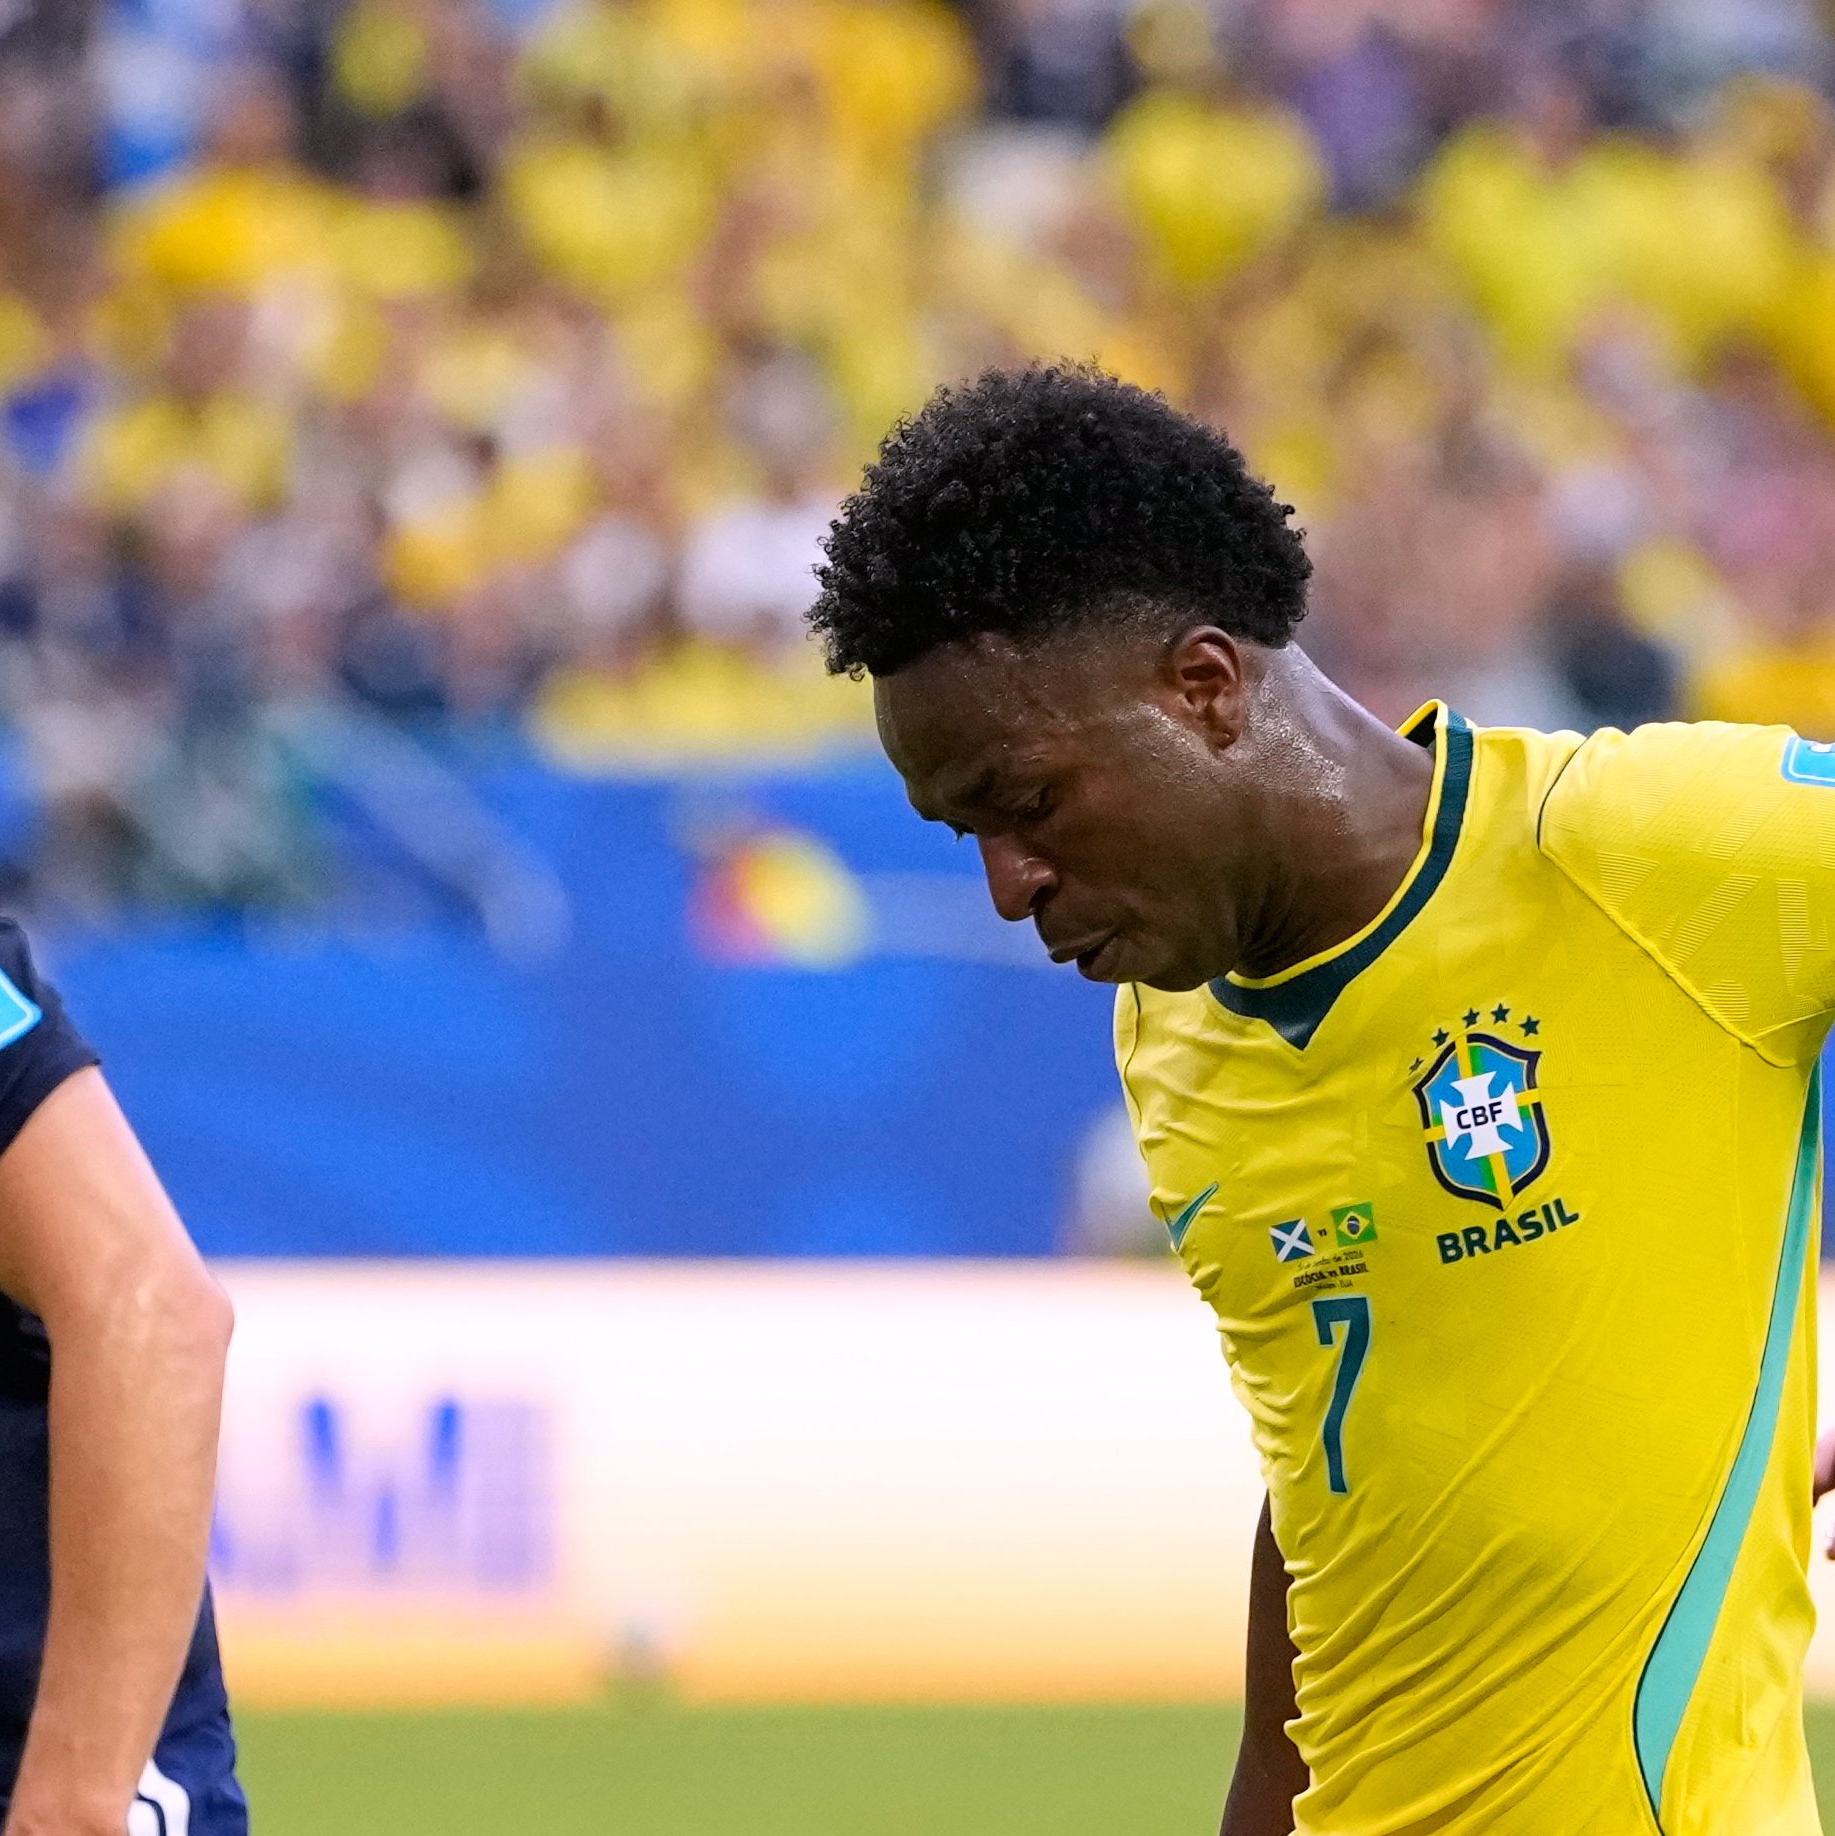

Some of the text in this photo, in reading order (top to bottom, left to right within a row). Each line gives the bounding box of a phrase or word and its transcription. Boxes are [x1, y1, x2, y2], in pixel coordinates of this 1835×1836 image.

[1456, 1101, 1503, 1130] CBF
[1436, 1198, 1580, 1264] BRASIL
[1310, 1296, 1372, 1494] 7
